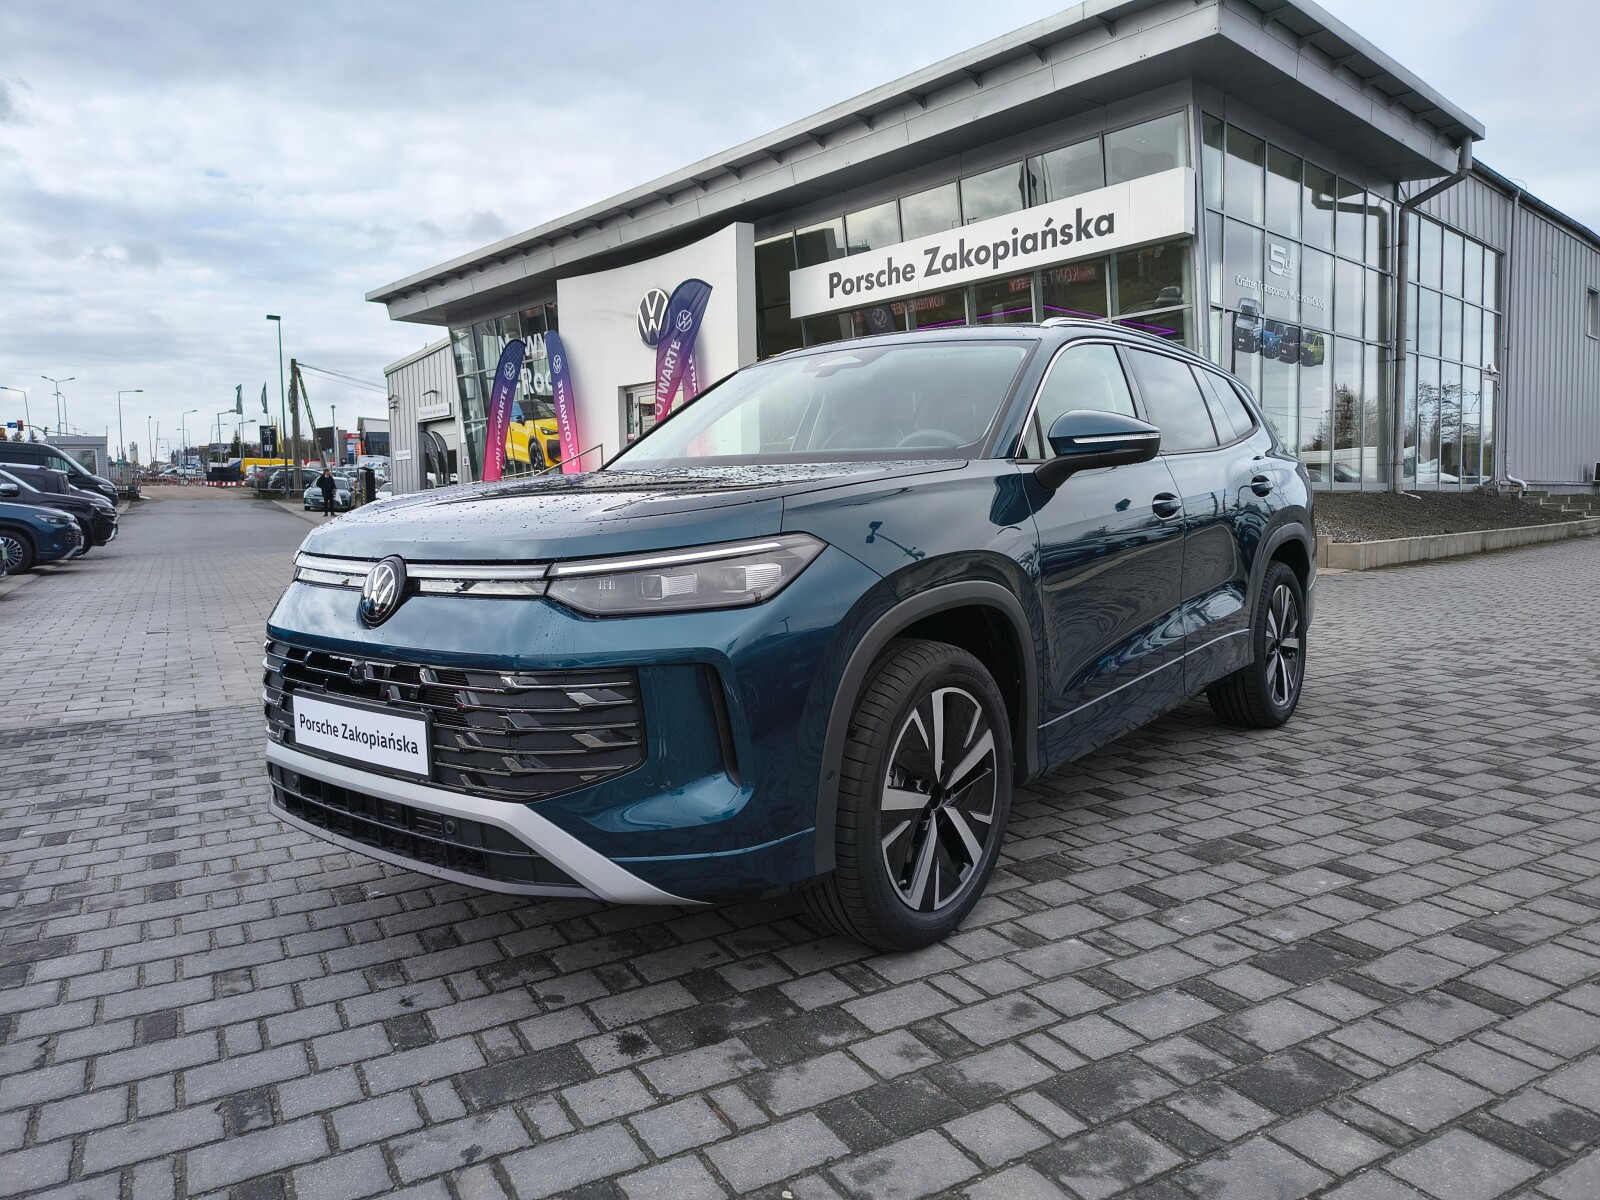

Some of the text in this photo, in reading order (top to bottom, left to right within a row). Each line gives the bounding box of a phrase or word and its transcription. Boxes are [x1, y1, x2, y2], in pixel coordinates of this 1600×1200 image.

[828, 207, 1116, 299] Porsche Zakopiańska
[497, 331, 549, 360] Nwy
[299, 713, 419, 755] Porsche Zakopiańska
